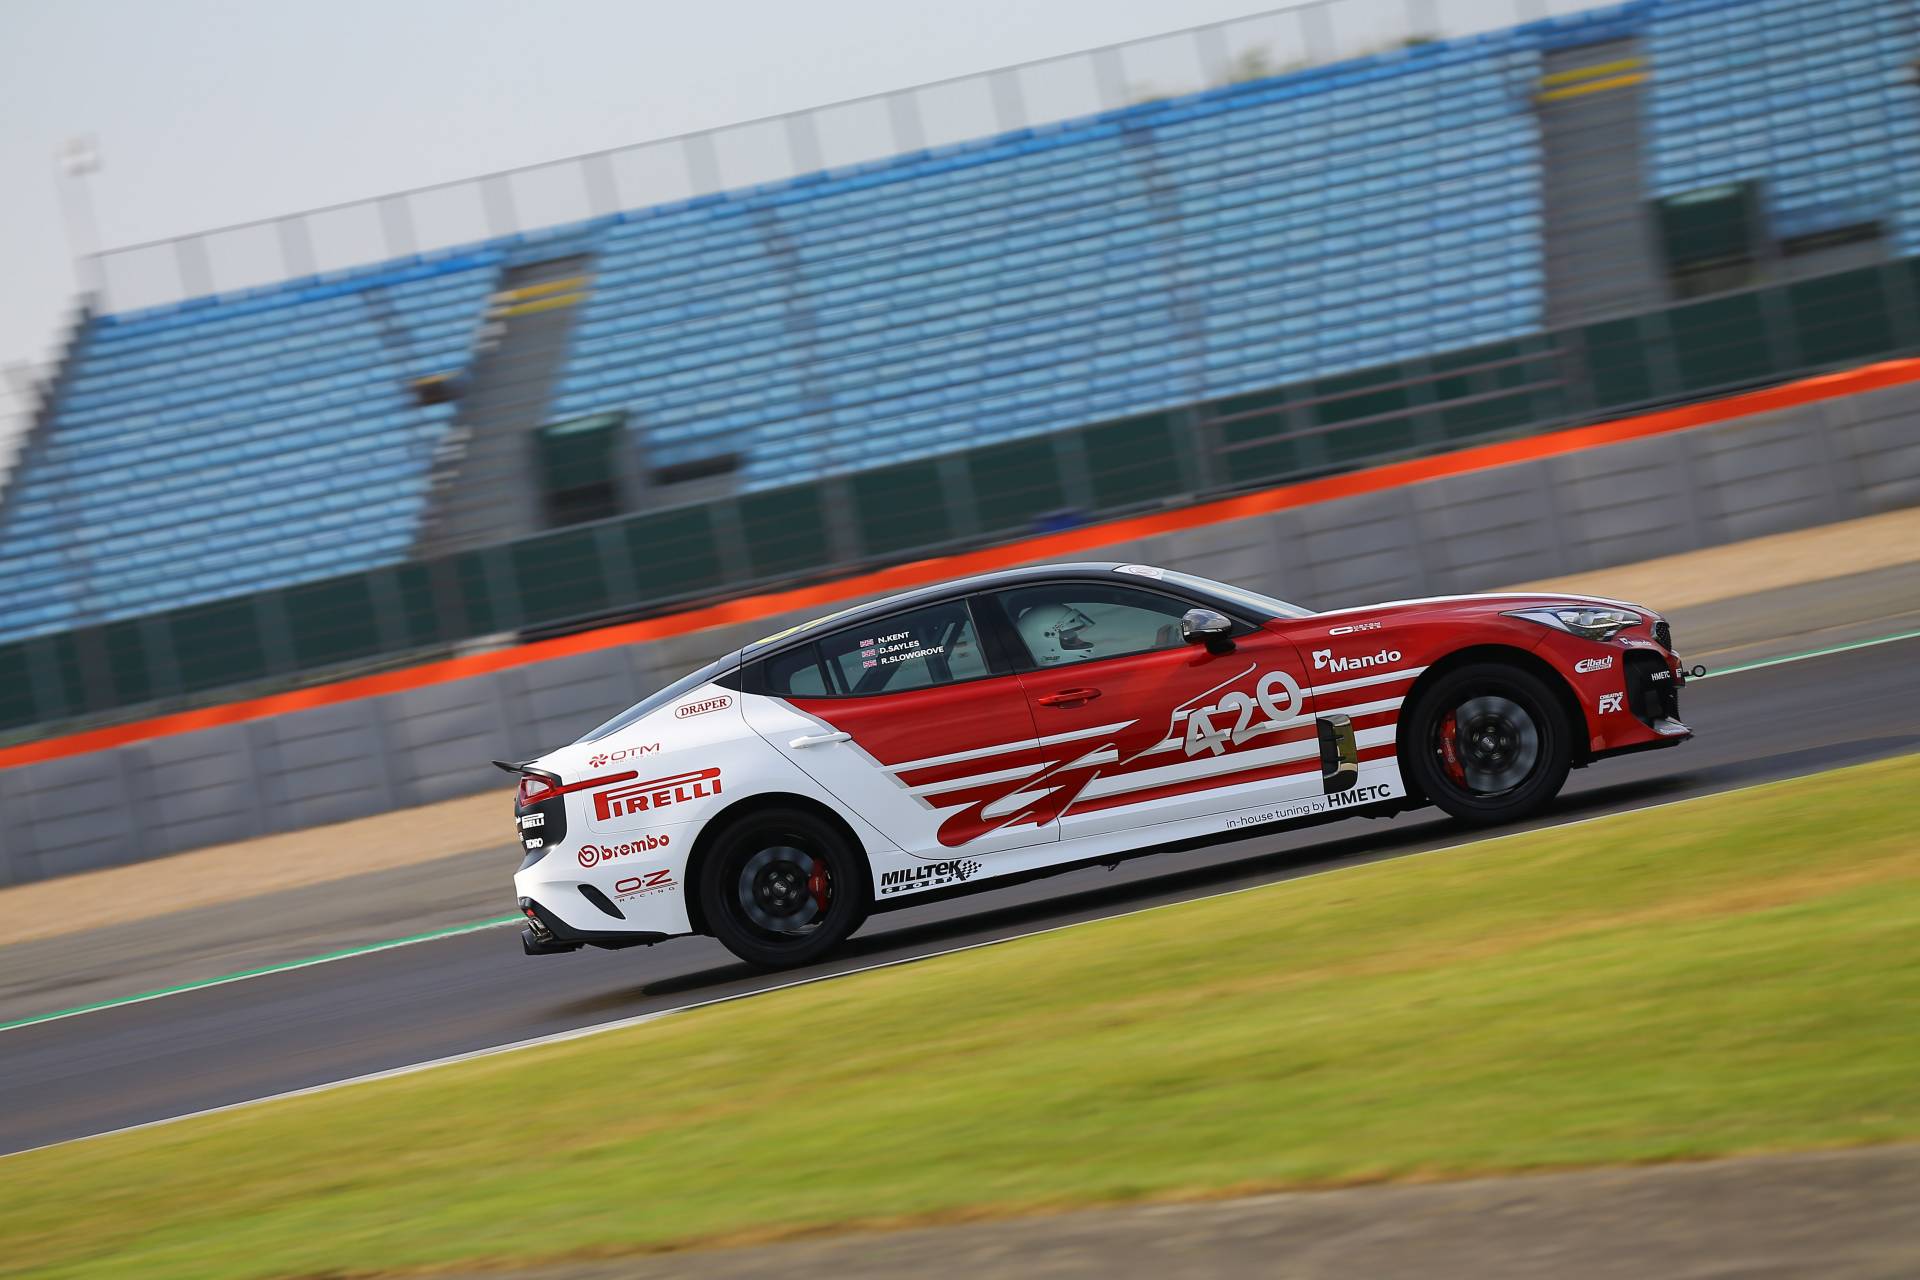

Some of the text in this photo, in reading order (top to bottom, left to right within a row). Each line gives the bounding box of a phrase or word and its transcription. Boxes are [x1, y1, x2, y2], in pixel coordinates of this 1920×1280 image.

[878, 631, 910, 644] N.KENT
[879, 640, 920, 654] D.SAYLES
[881, 646, 945, 665] R.SLOWGROVE
[1329, 650, 1402, 673] Mando
[1574, 655, 1613, 673] Eibach
[680, 698, 727, 717] DRAPER
[1184, 670, 1303, 758] 420
[1598, 697, 1623, 715] FX
[611, 743, 660, 761] OTM
[593, 767, 723, 822] PIRELLI
[1226, 783, 1391, 828] in-house tuning by HMETC
[602, 834, 670, 861] brembo
